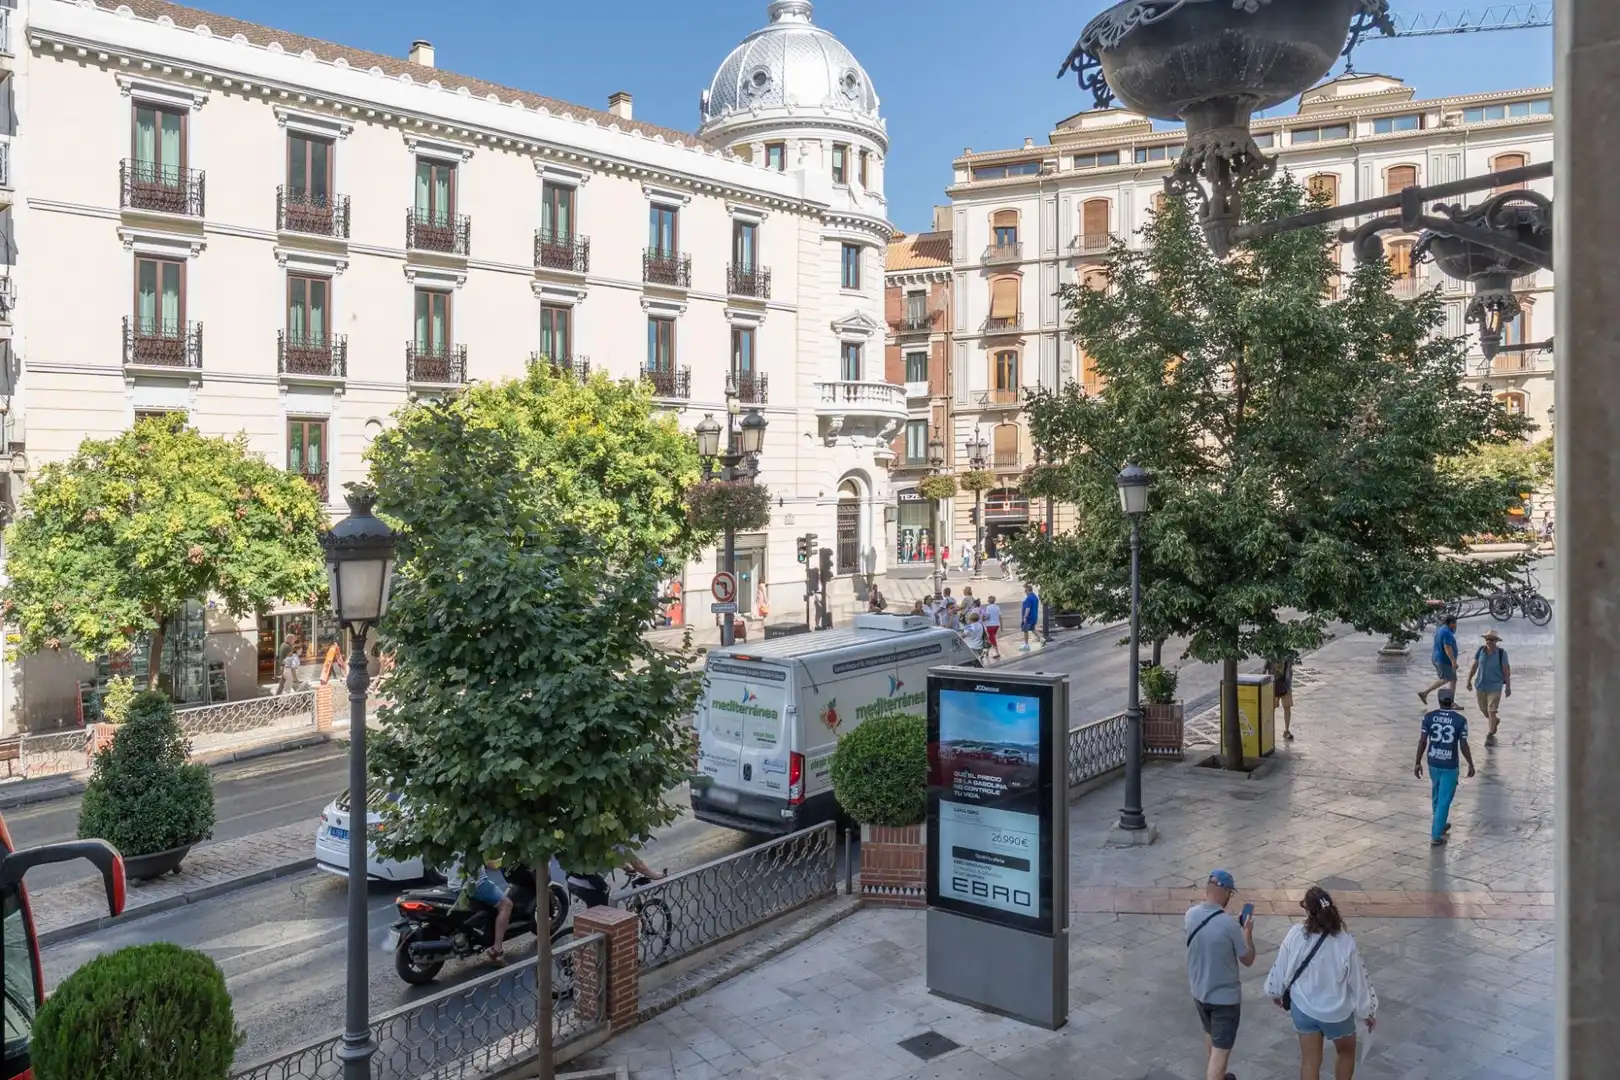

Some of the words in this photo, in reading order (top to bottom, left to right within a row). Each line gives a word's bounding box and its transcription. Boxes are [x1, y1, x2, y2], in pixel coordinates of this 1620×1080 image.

[712, 699, 778, 720] mediterránea
[1431, 723, 1455, 743] 33
[973, 780, 1008, 791] GASOLINA
[977, 774, 1002, 783] PRECIO
[964, 785, 1001, 796] CONTROLE
[953, 877, 1030, 906] EBRO
